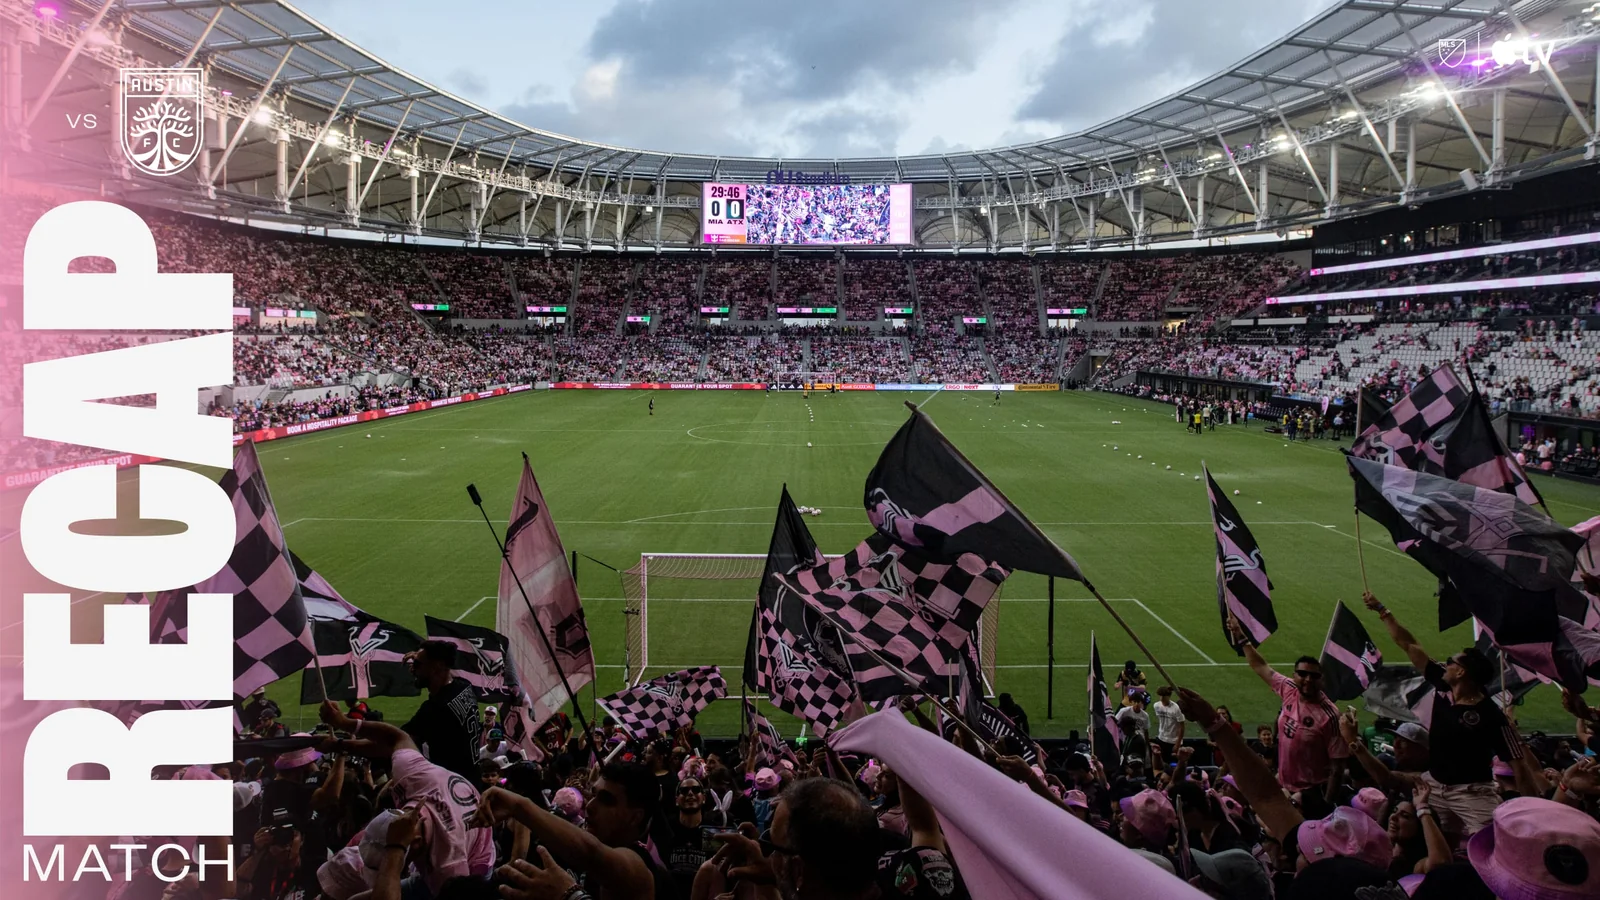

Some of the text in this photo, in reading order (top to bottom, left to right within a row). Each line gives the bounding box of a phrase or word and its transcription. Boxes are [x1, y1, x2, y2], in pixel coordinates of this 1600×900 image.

[711, 186, 740, 198] 29:46
[711, 200, 740, 218] 0 0
[286, 424, 301, 434] BOOK
[307, 418, 338, 431] HOSPITALITY
